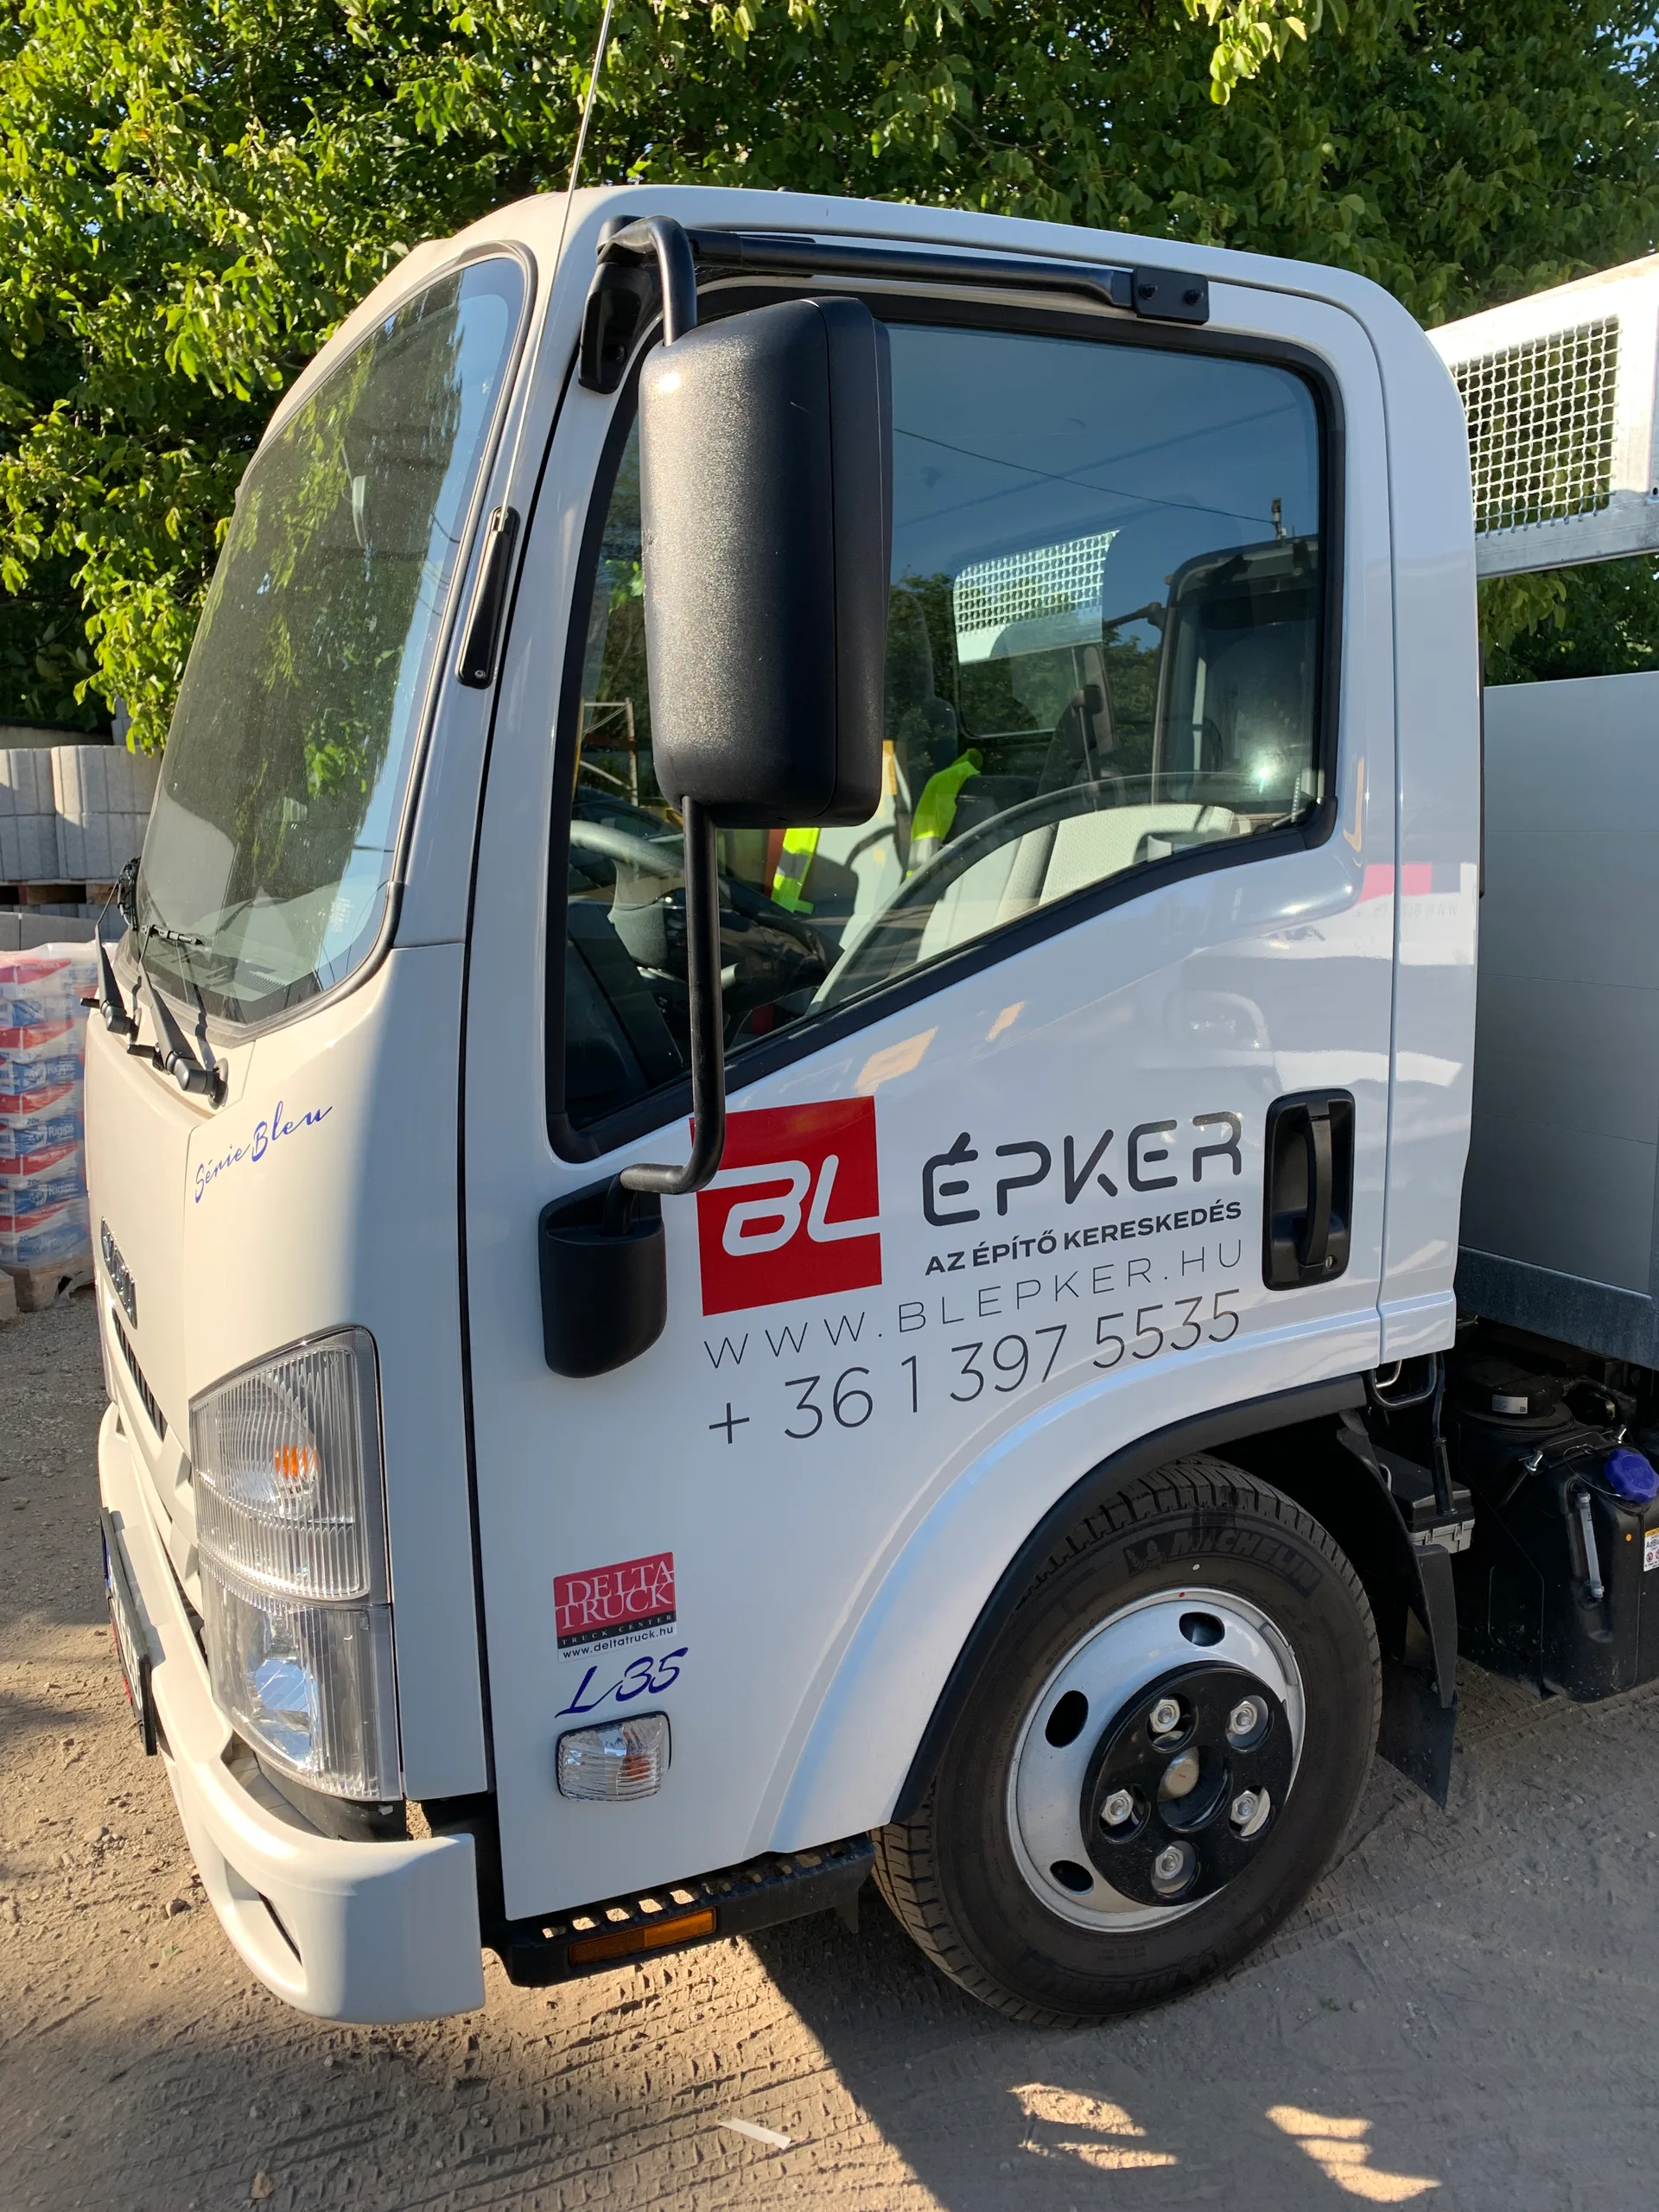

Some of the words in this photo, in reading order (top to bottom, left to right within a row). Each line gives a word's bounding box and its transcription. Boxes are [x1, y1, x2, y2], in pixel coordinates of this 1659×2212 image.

[251, 1100, 333, 1162] Bleu
[922, 1110, 1243, 1227] ÉPKER
[696, 1154, 880, 1256] BL
[925, 1253, 965, 1276] AZ
[972, 1228, 1057, 1268] ÉPÍTŐ
[1064, 1198, 1243, 1250] KERESKEDÉS
[703, 1239, 1242, 1370] WWW.BLEPKER.HU
[785, 1366, 874, 1439] 36
[900, 1354, 918, 1414] 1
[950, 1324, 1068, 1402] 397
[1093, 1288, 1241, 1370] 5535
[564, 1560, 674, 1605] DELTA
[1169, 1529, 1324, 1591] MICHELIN
[555, 1583, 673, 1630] TRUCK
[562, 1630, 608, 1646] TRUCK
[619, 1615, 672, 1633] CENTER
[563, 1625, 674, 1659] www.deltatruck.hu
[554, 1646, 689, 1719] L35
